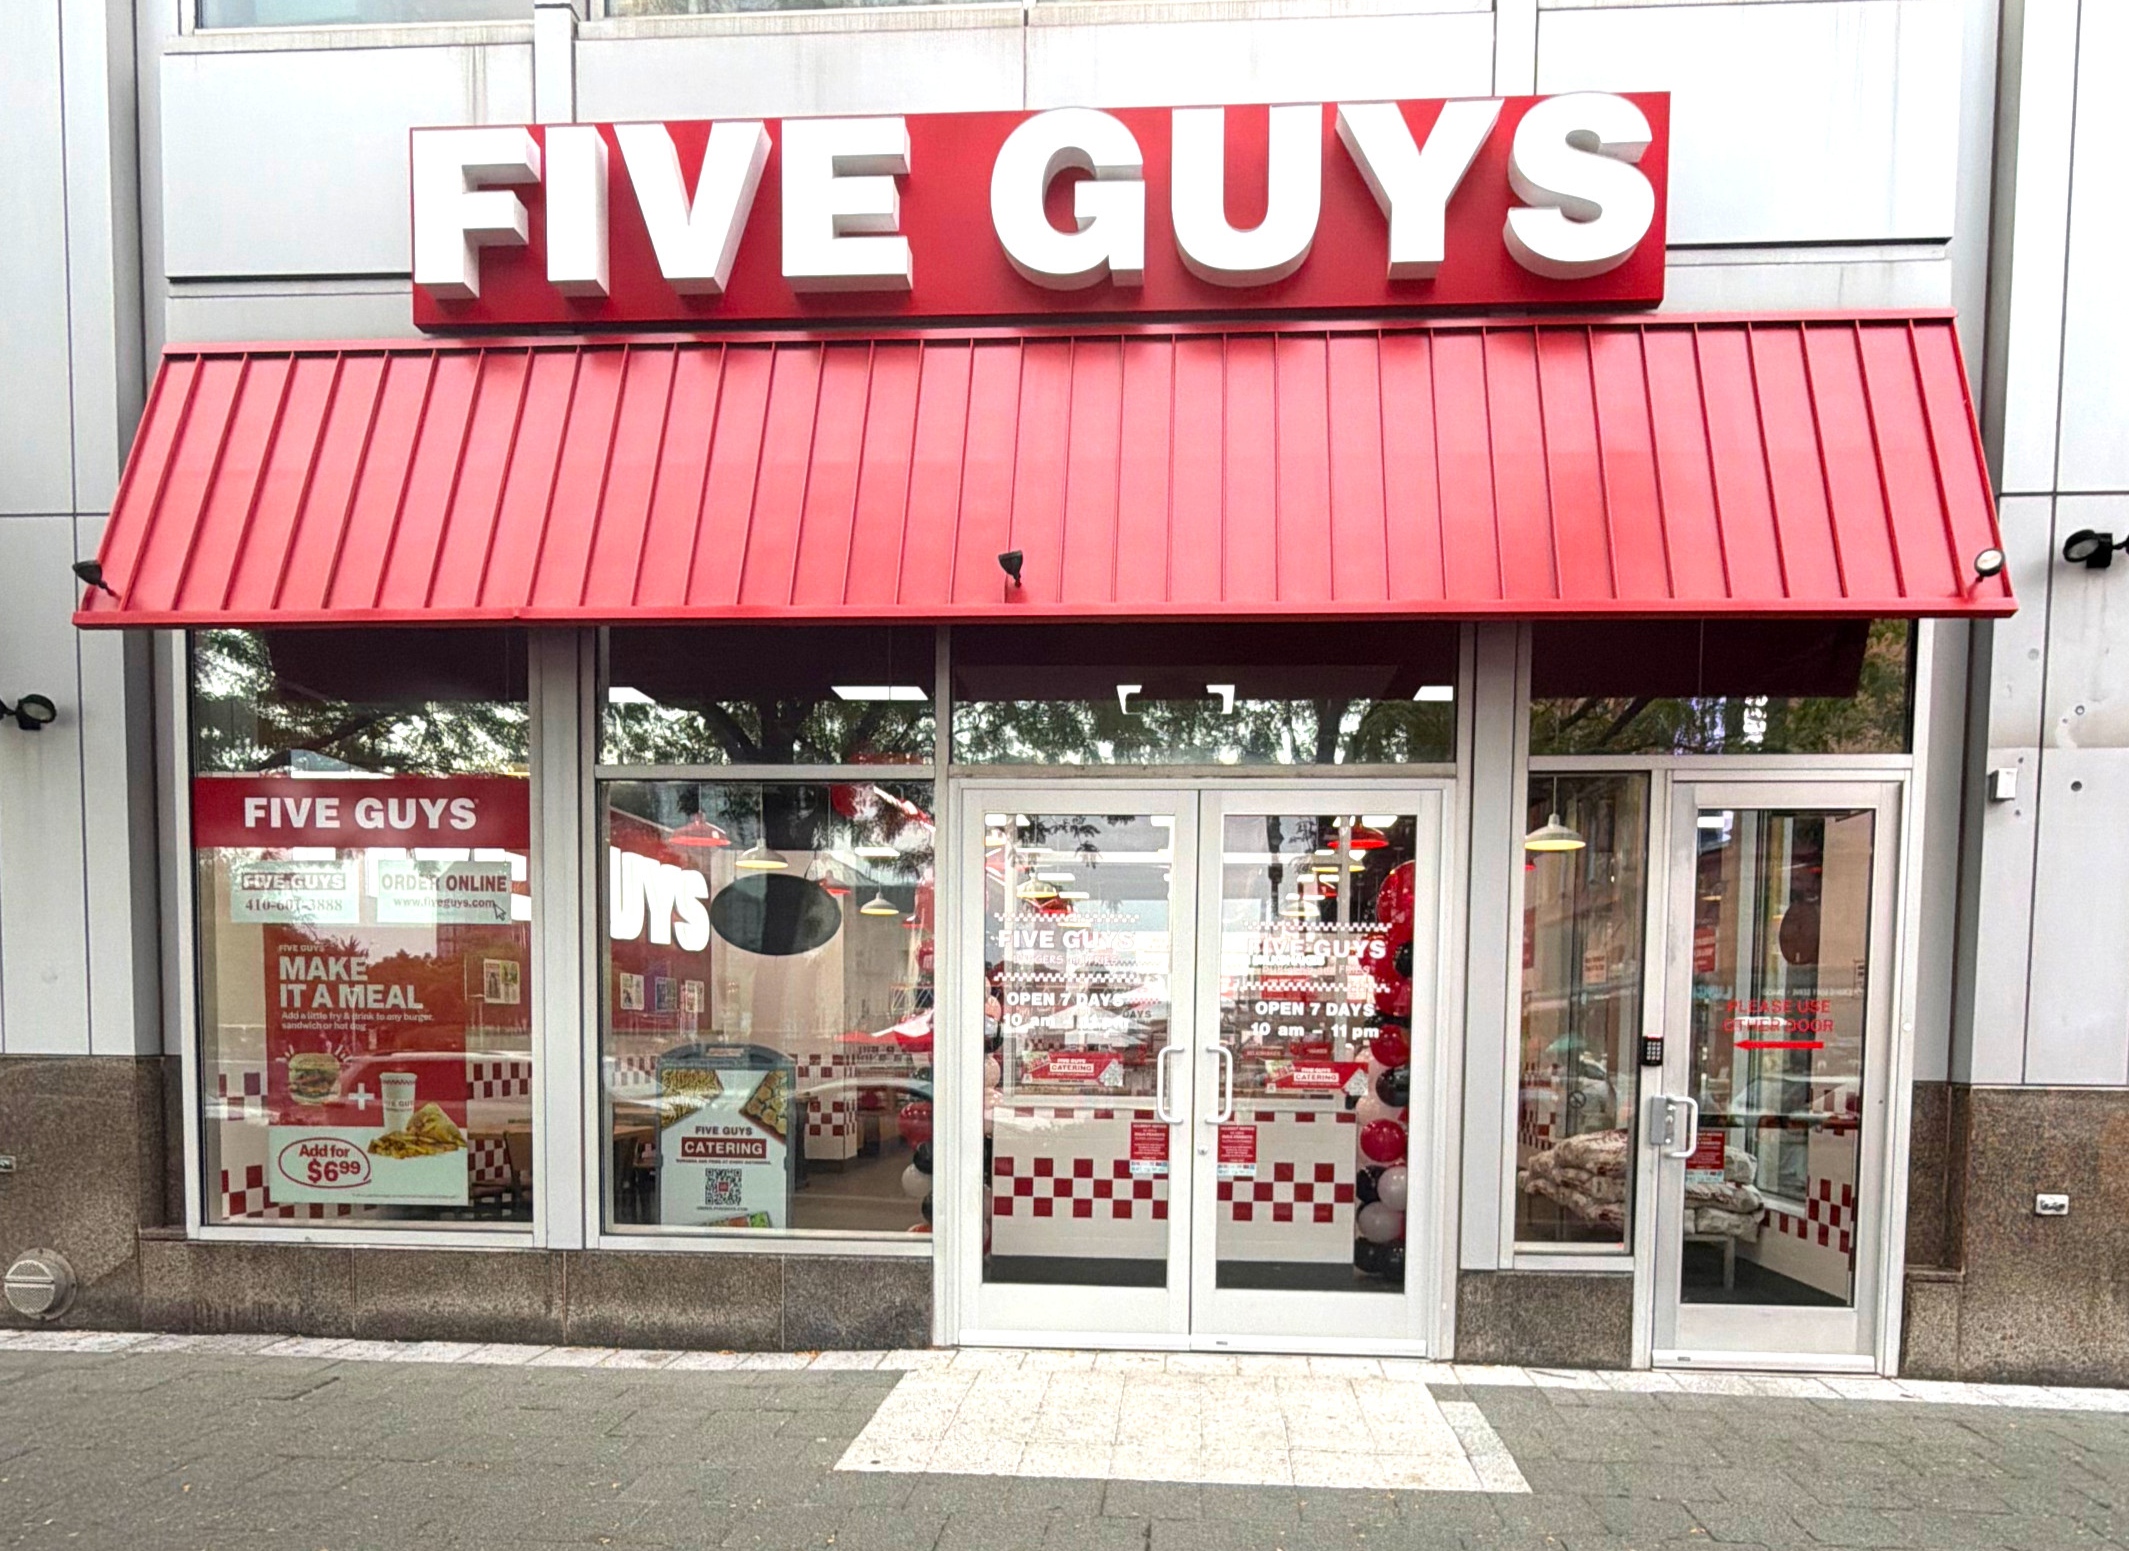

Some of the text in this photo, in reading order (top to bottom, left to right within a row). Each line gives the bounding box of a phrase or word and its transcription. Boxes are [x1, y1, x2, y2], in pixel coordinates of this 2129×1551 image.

[411, 91, 1656, 298] FIVE GUYS
[245, 797, 476, 829] FIVE GUYS
[243, 874, 344, 889] FIVE GUYS
[381, 873, 507, 892] ORDER ONLINE
[393, 897, 494, 908] www.fiveguys.com
[999, 929, 1135, 949] FIVE GUYS
[279, 944, 298, 952] FIVE
[1248, 939, 1387, 959] FIVE GUYS
[279, 956, 368, 981] MAKE
[280, 983, 424, 1009] IT A MEAL
[1006, 992, 1125, 1007] OPEN 7 DAYS
[1255, 1001, 1376, 1017] OPEN 7 DAYS
[1727, 1000, 1831, 1014] PLEASE USE
[282, 1011, 299, 1020] Add
[307, 1011, 327, 1020] little
[329, 1011, 341, 1022] fry
[352, 1012, 374, 1020] drink
[376, 1012, 385, 1020] to
[386, 1014, 402, 1022] any
[1003, 1012, 1023, 1026] 10
[1029, 1015, 1056, 1027] am
[282, 1021, 322, 1029] sandwich
[334, 1021, 349, 1030] hot
[1250, 1022, 1271, 1036] 10
[1278, 1025, 1304, 1036] am
[1331, 1024, 1347, 1037] 11
[1352, 1027, 1379, 1040] pm
[1722, 1019, 1834, 1032] OTHER DOOR
[1051, 1064, 1092, 1072] CATERING
[695, 1126, 753, 1135] FIVE GUYS
[299, 1144, 350, 1157] Add for
[684, 1141, 763, 1155] CATERING
